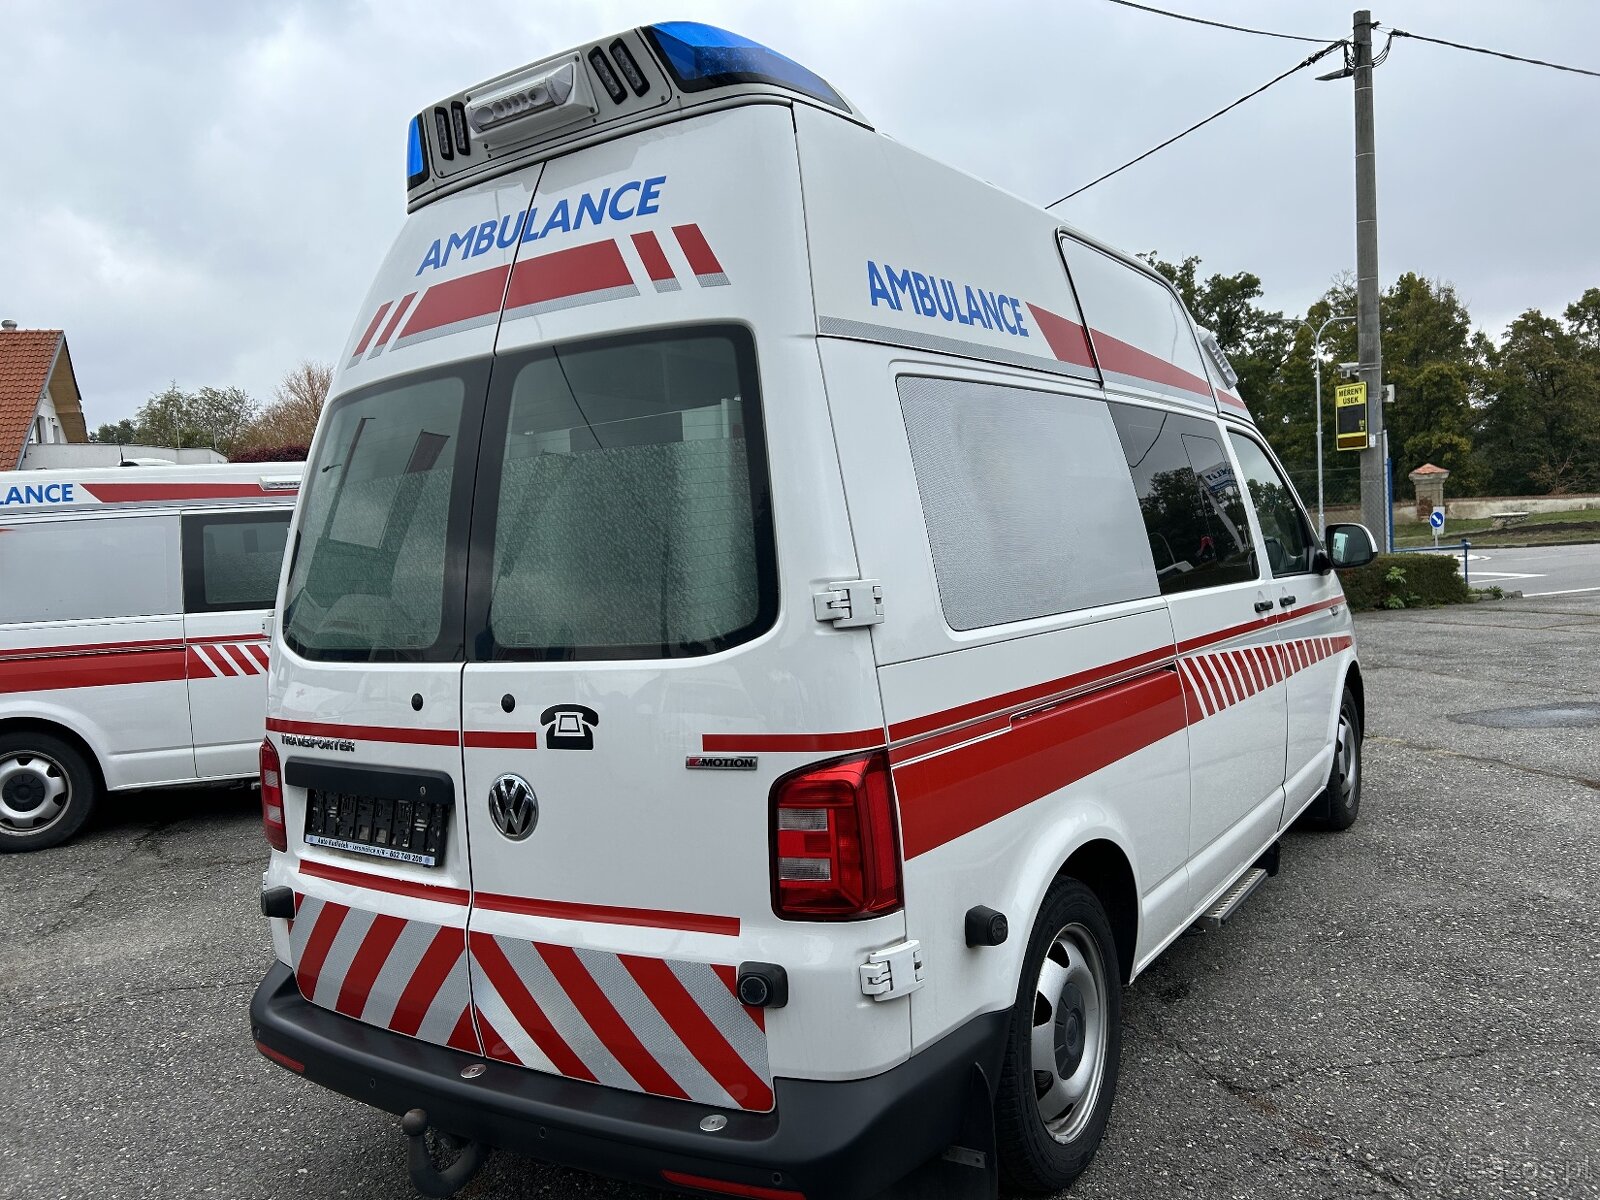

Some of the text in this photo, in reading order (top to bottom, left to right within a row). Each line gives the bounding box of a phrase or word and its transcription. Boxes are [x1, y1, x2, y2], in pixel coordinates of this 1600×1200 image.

[415, 175, 667, 277] AMBULANCE
[867, 260, 1029, 338] AMBULANCE
[281, 732, 355, 752] TRANSPORTER
